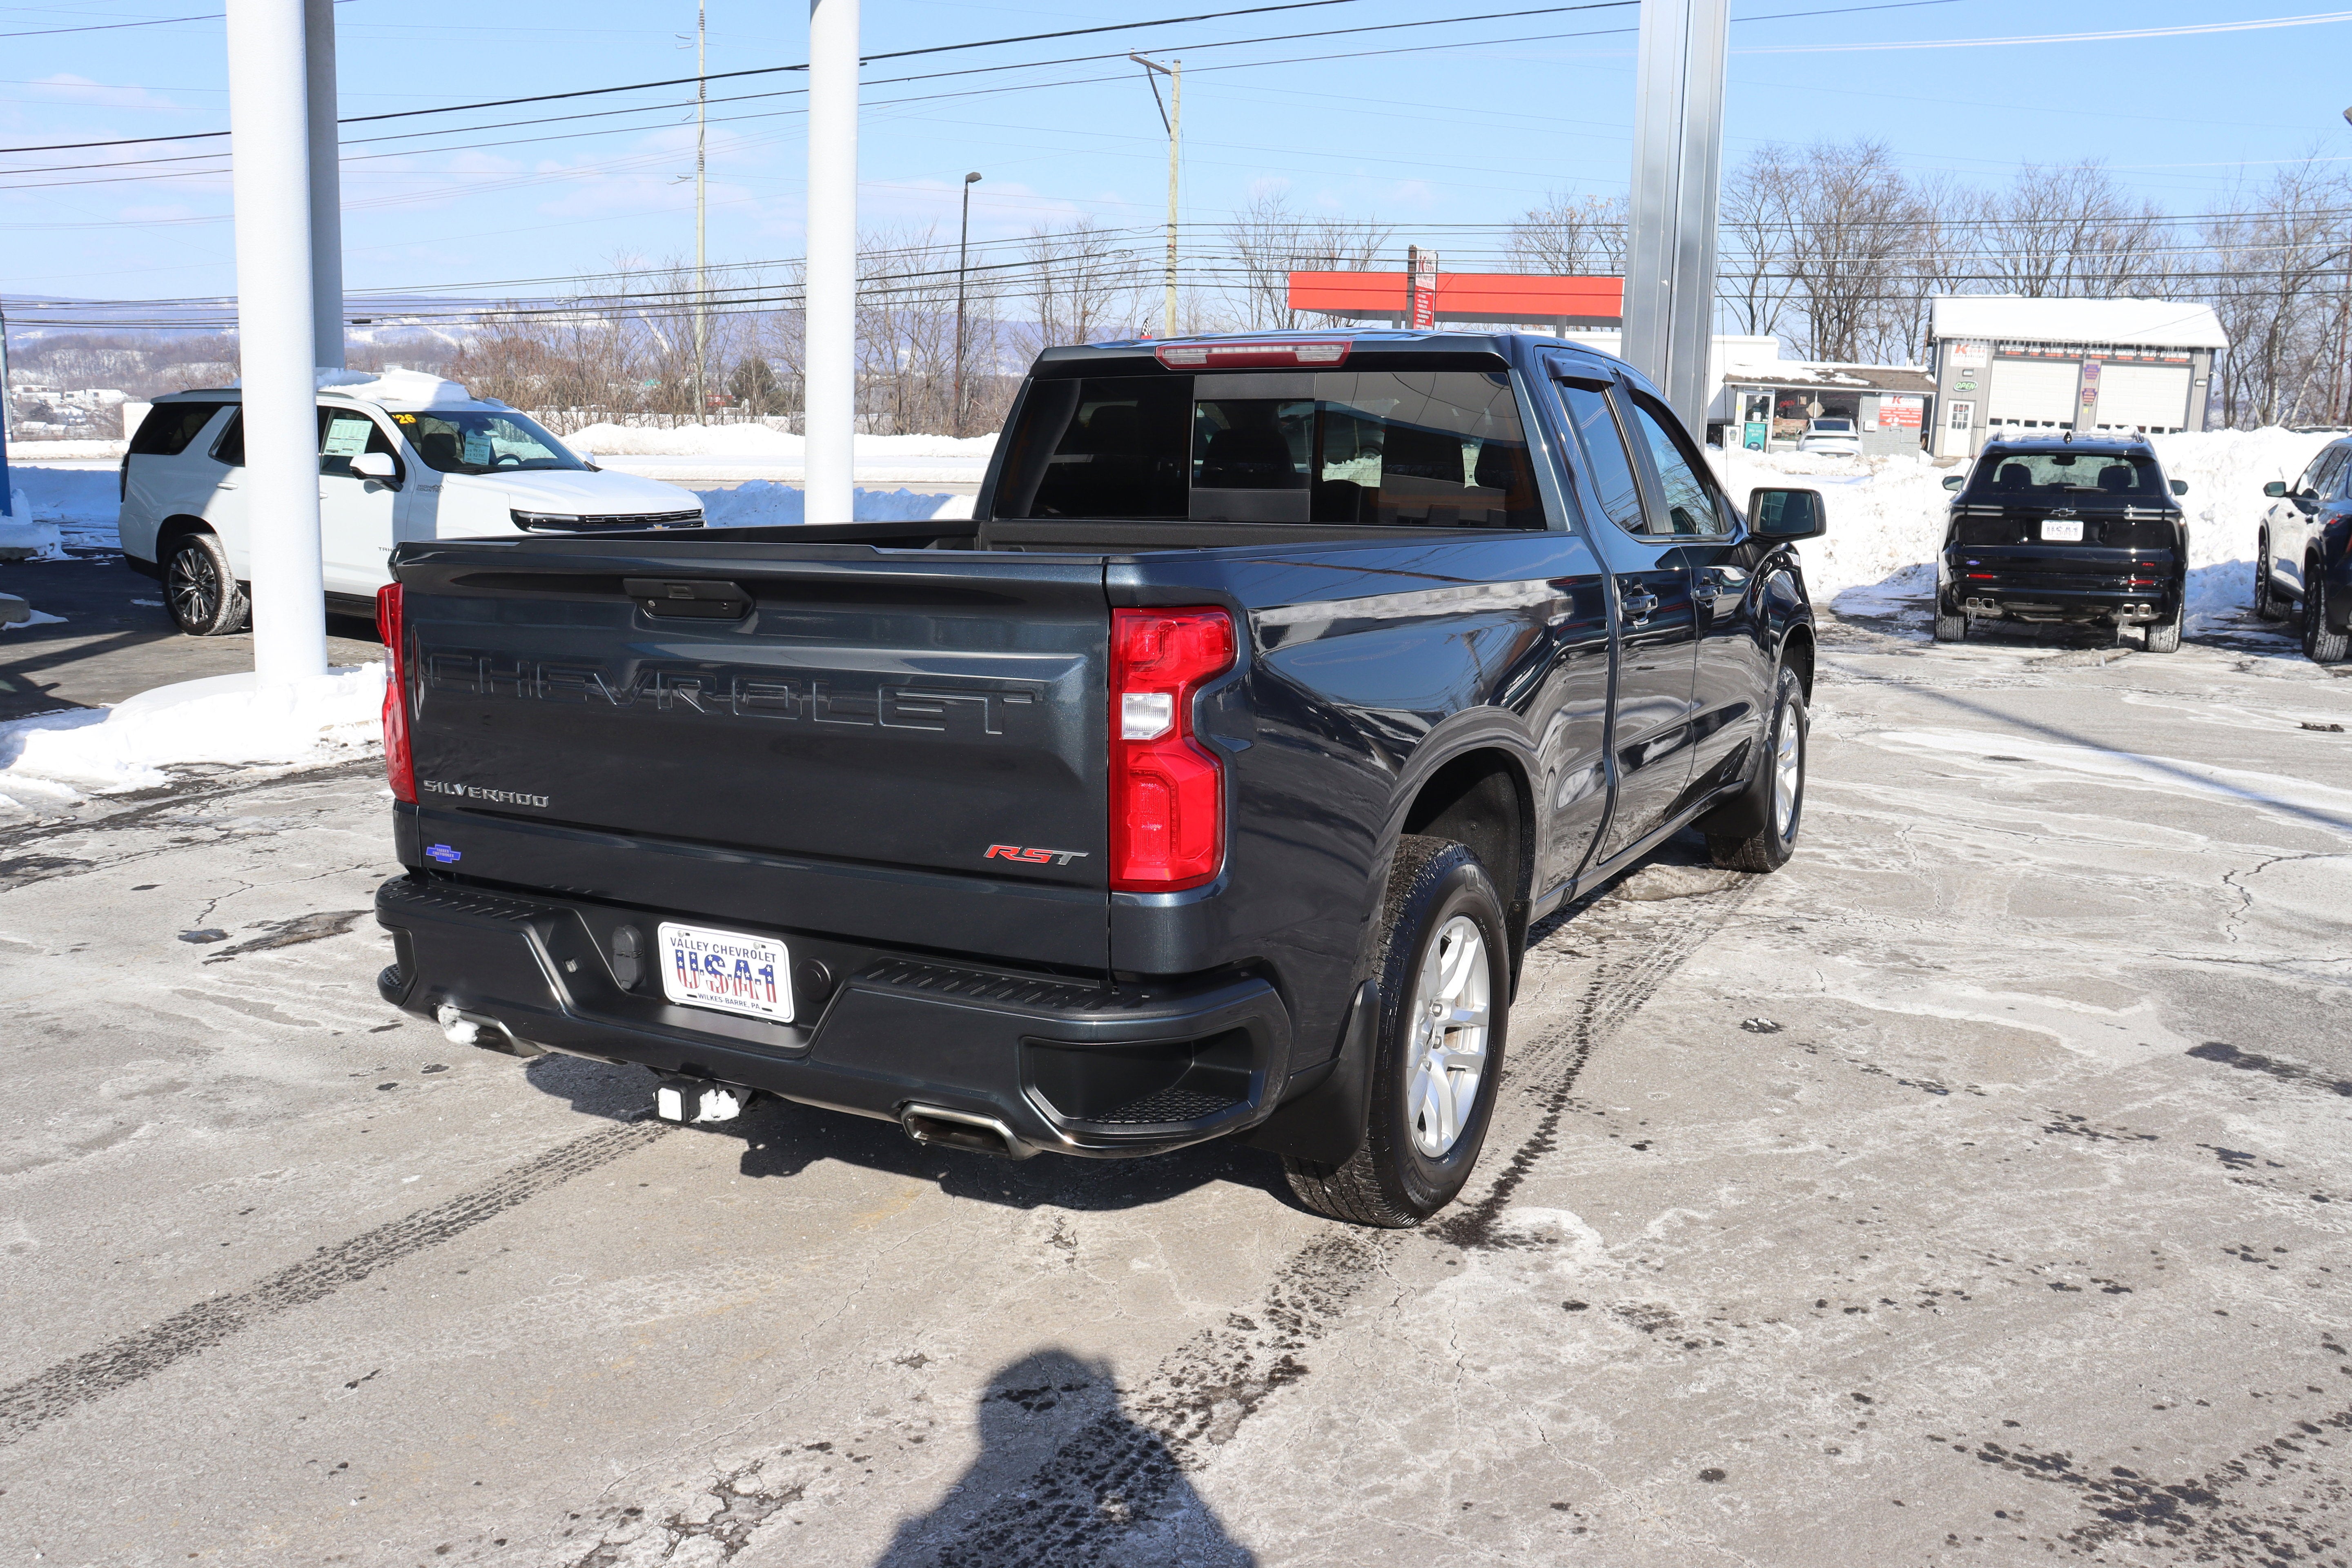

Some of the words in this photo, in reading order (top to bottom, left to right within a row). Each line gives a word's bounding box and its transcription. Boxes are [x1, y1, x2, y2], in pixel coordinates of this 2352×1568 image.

[392, 414, 416, 424] '26
[429, 652, 1038, 735] CHEVROLET
[423, 780, 549, 808] SILVERADO
[983, 844, 1089, 866] RST
[670, 937, 709, 952] VALLEY
[713, 944, 776, 963] CHEVROLET
[697, 993, 750, 1009] WILKES-BARRE,
